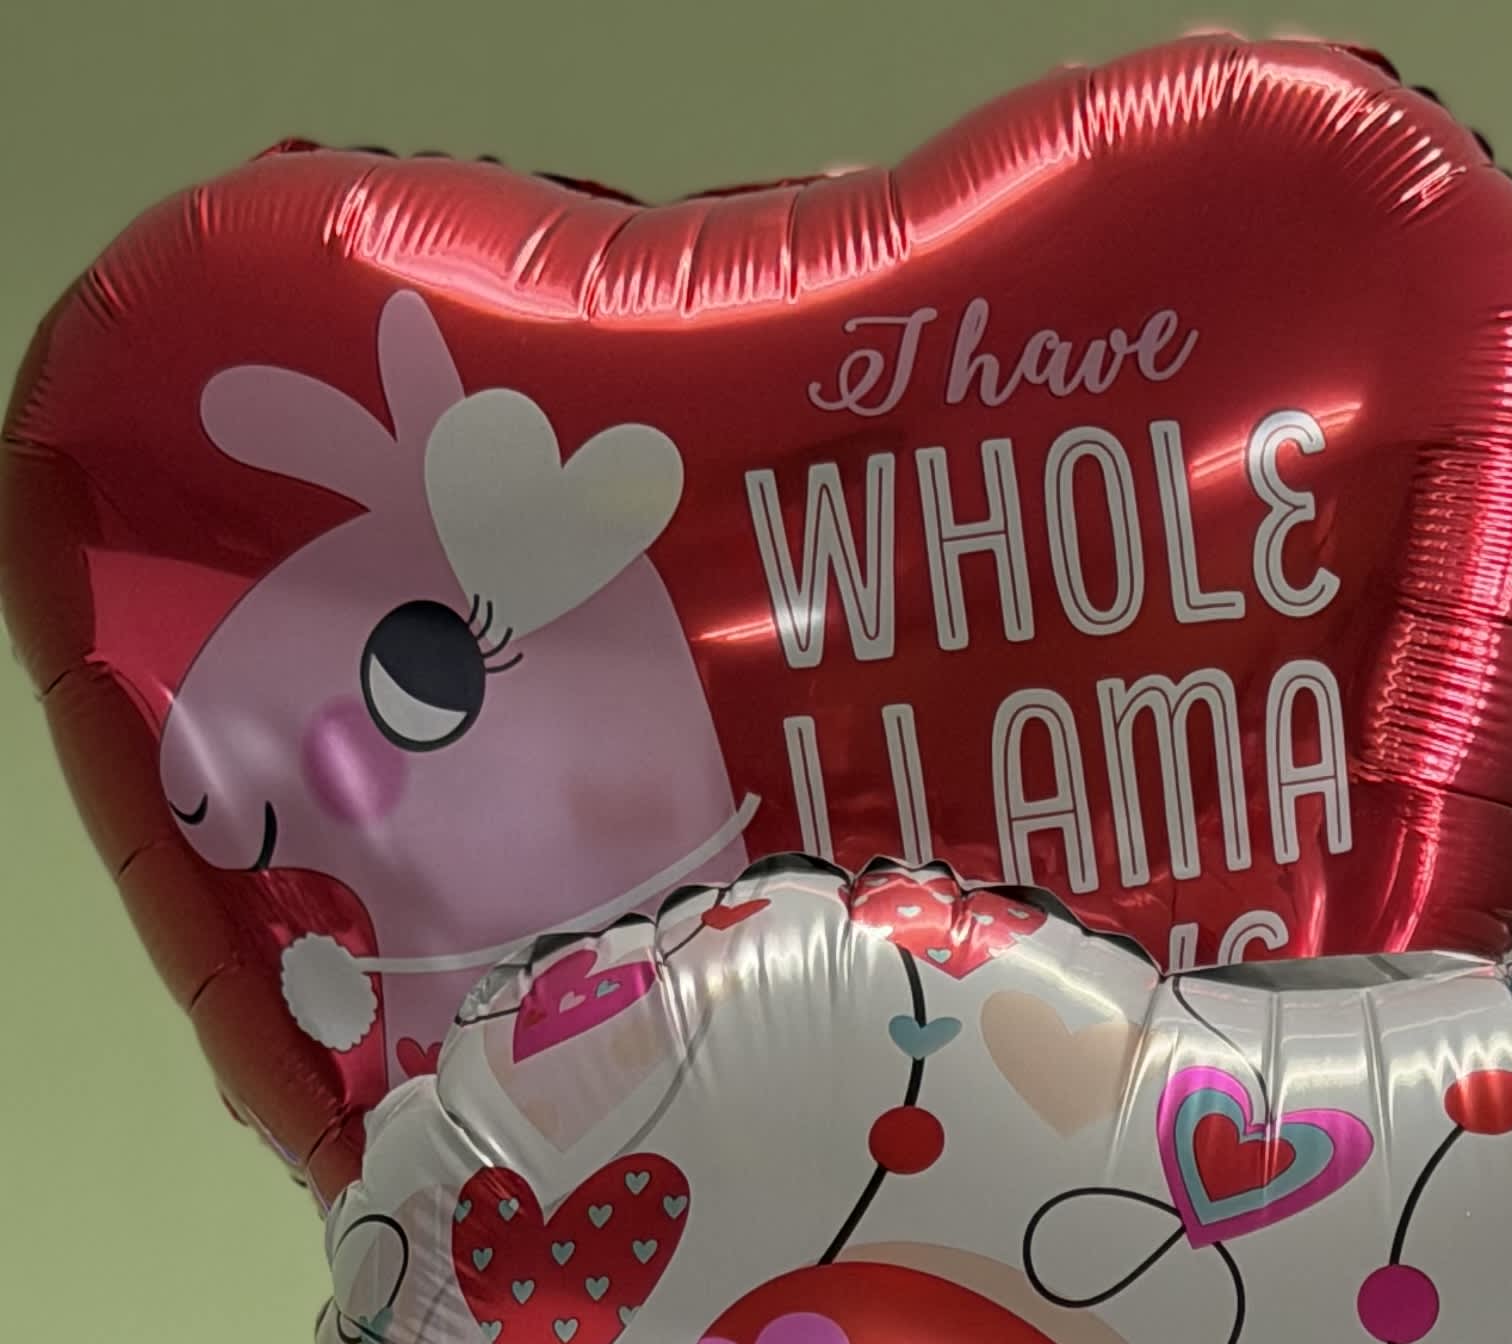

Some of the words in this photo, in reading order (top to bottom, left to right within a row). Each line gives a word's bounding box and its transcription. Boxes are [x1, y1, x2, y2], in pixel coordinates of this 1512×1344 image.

[808, 307, 938, 416] I
[946, 297, 1199, 408] have
[744, 410, 1341, 669] WHOLE
